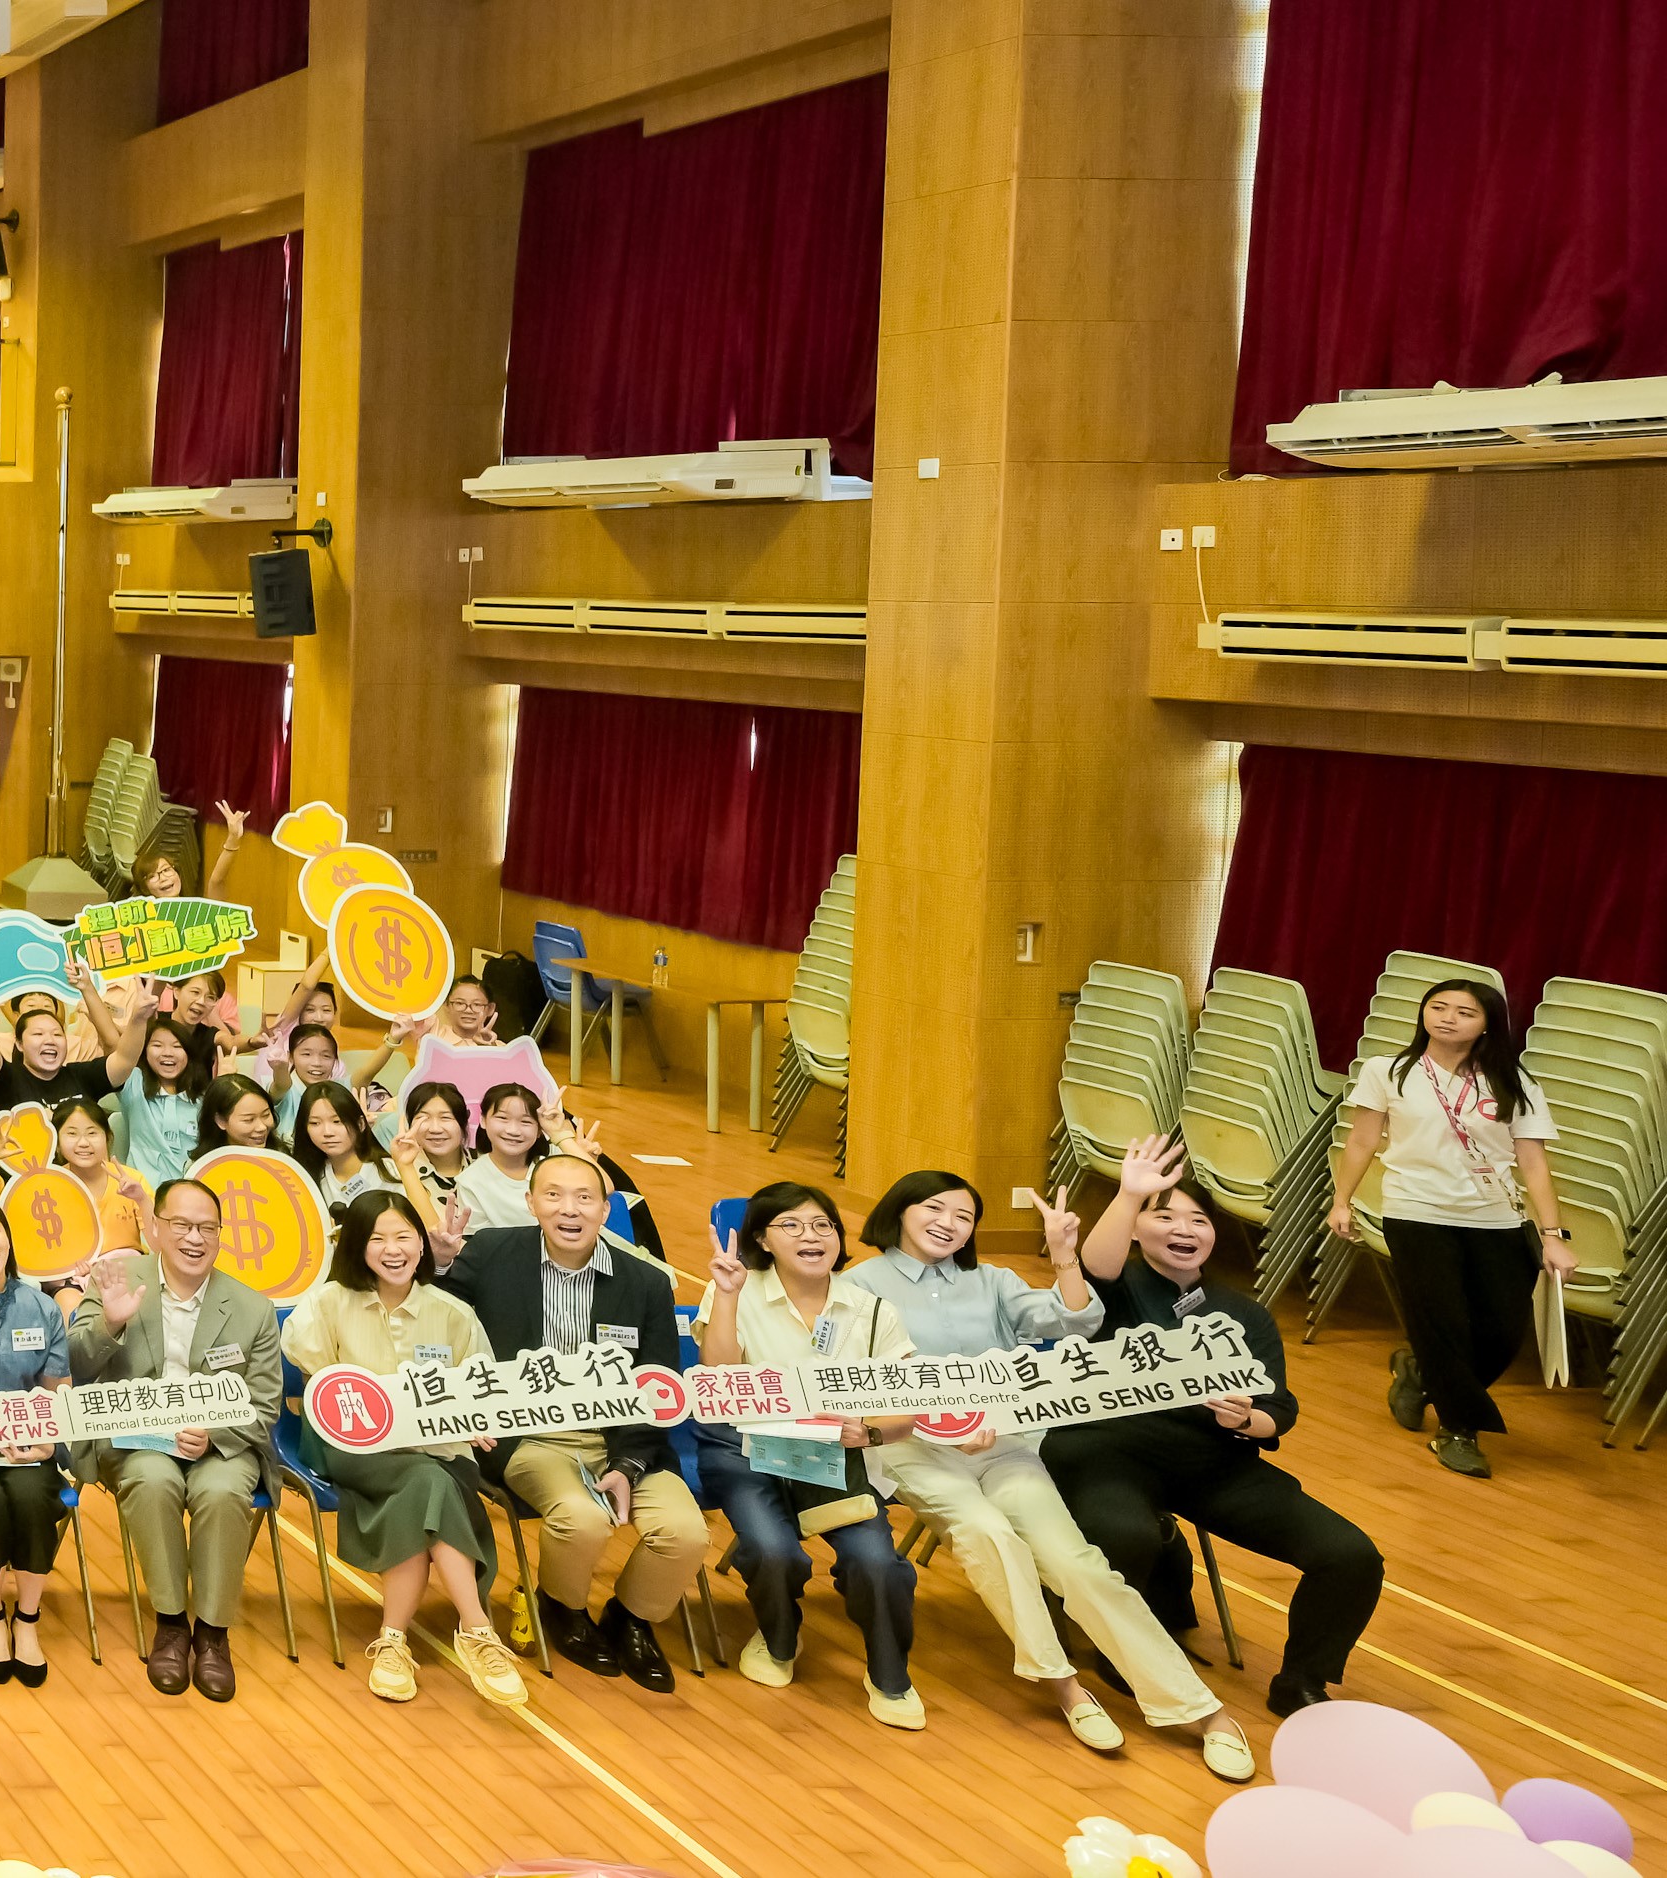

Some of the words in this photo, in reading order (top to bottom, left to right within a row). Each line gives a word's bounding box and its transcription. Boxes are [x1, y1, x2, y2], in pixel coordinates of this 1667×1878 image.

[85, 900, 150, 934] 理財
[79, 1375, 244, 1417] 理財教育中心
[402, 1348, 629, 1409] 恒生銀行
[691, 1367, 784, 1398] 家福會
[814, 1360, 1012, 1392] 理財教育中心
[1013, 1395, 1088, 1424] HANG
[1098, 1382, 1174, 1409] SENG
[1184, 1366, 1265, 1395] BANK
[84, 1417, 141, 1433] Financial
[144, 1412, 205, 1429] Education
[209, 1407, 251, 1421] Centre
[417, 1414, 489, 1438] HANG
[497, 1405, 565, 1430] SENG
[575, 1396, 647, 1421] BANK
[697, 1396, 792, 1417] HKFWS
[822, 1396, 888, 1411] Financial
[891, 1395, 964, 1408] Education
[968, 1392, 1021, 1406] Centre
